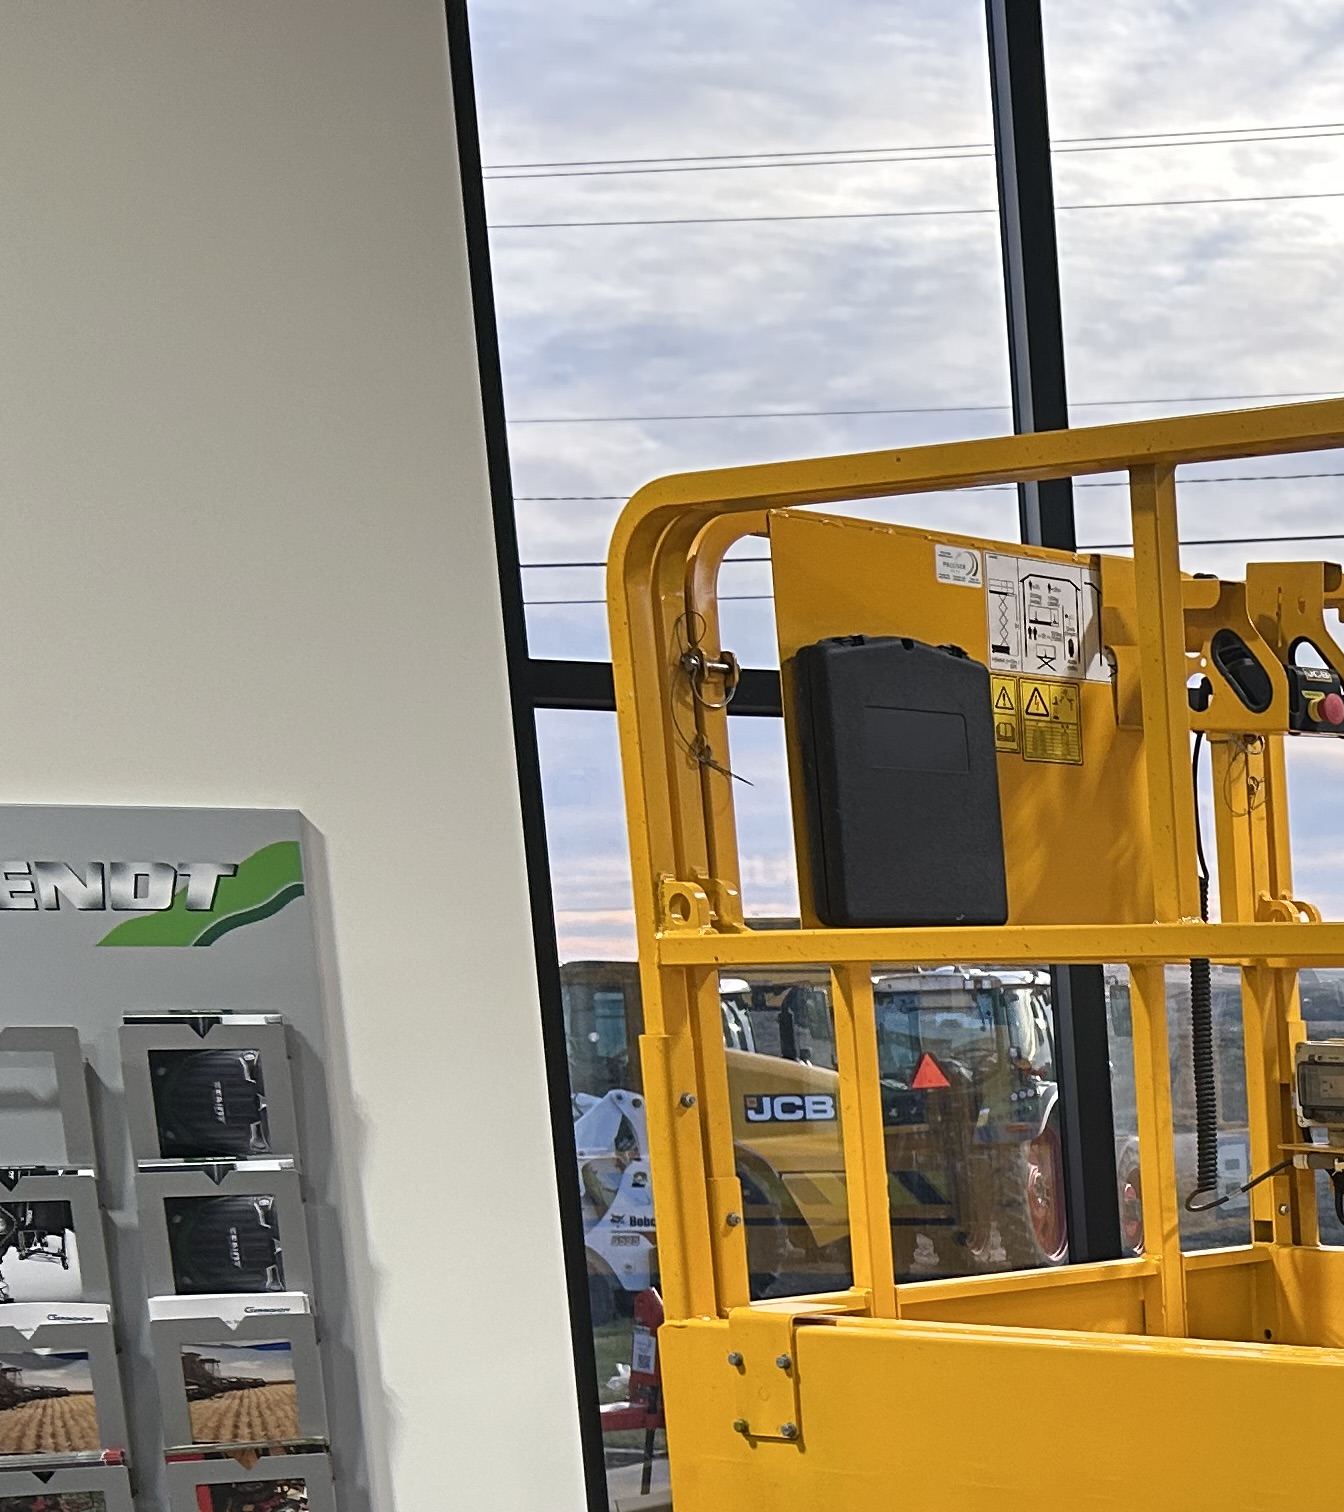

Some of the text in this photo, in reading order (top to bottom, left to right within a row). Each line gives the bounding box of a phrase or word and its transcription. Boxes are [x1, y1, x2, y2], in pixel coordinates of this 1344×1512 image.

[0, 861, 239, 912] ENDT
[746, 1094, 836, 1121] JCB
[629, 1215, 656, 1227] Bobc
